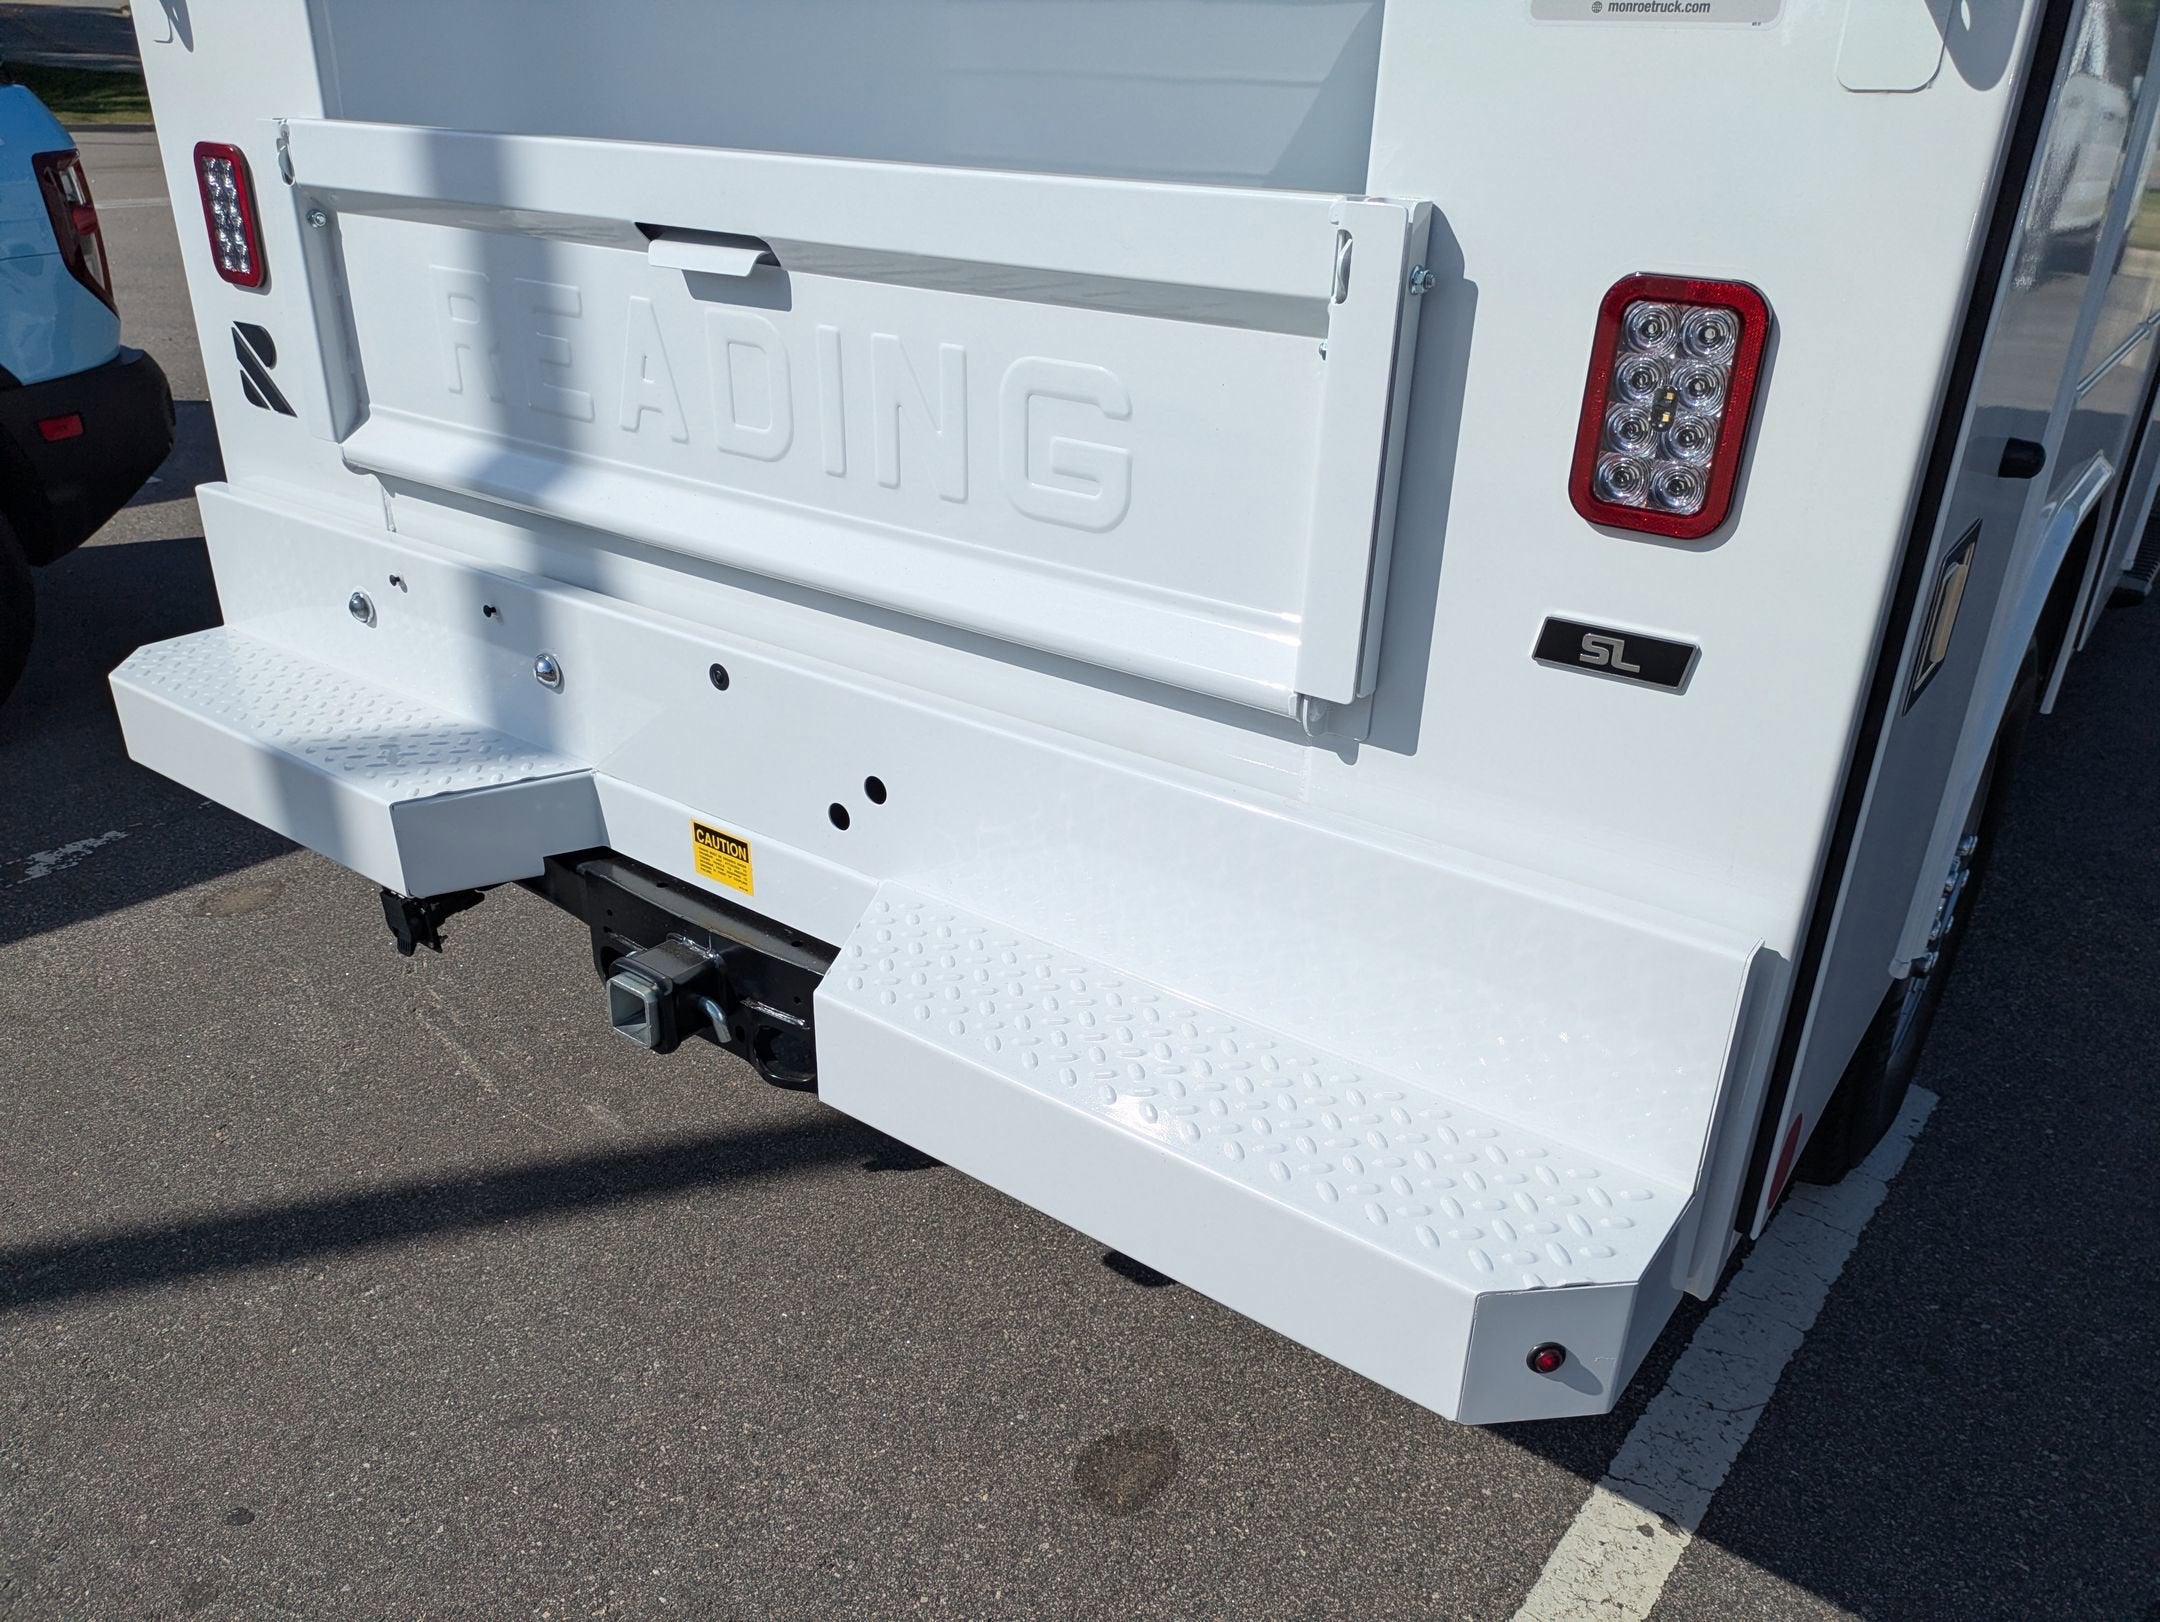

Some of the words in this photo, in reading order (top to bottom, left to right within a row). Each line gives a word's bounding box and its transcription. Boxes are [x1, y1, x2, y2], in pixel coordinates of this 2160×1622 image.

[1608, 0, 1711, 14] monroetruck.com
[428, 264, 1133, 534] READING
[1579, 632, 1641, 674] SL
[696, 829, 747, 861] CAUTION
